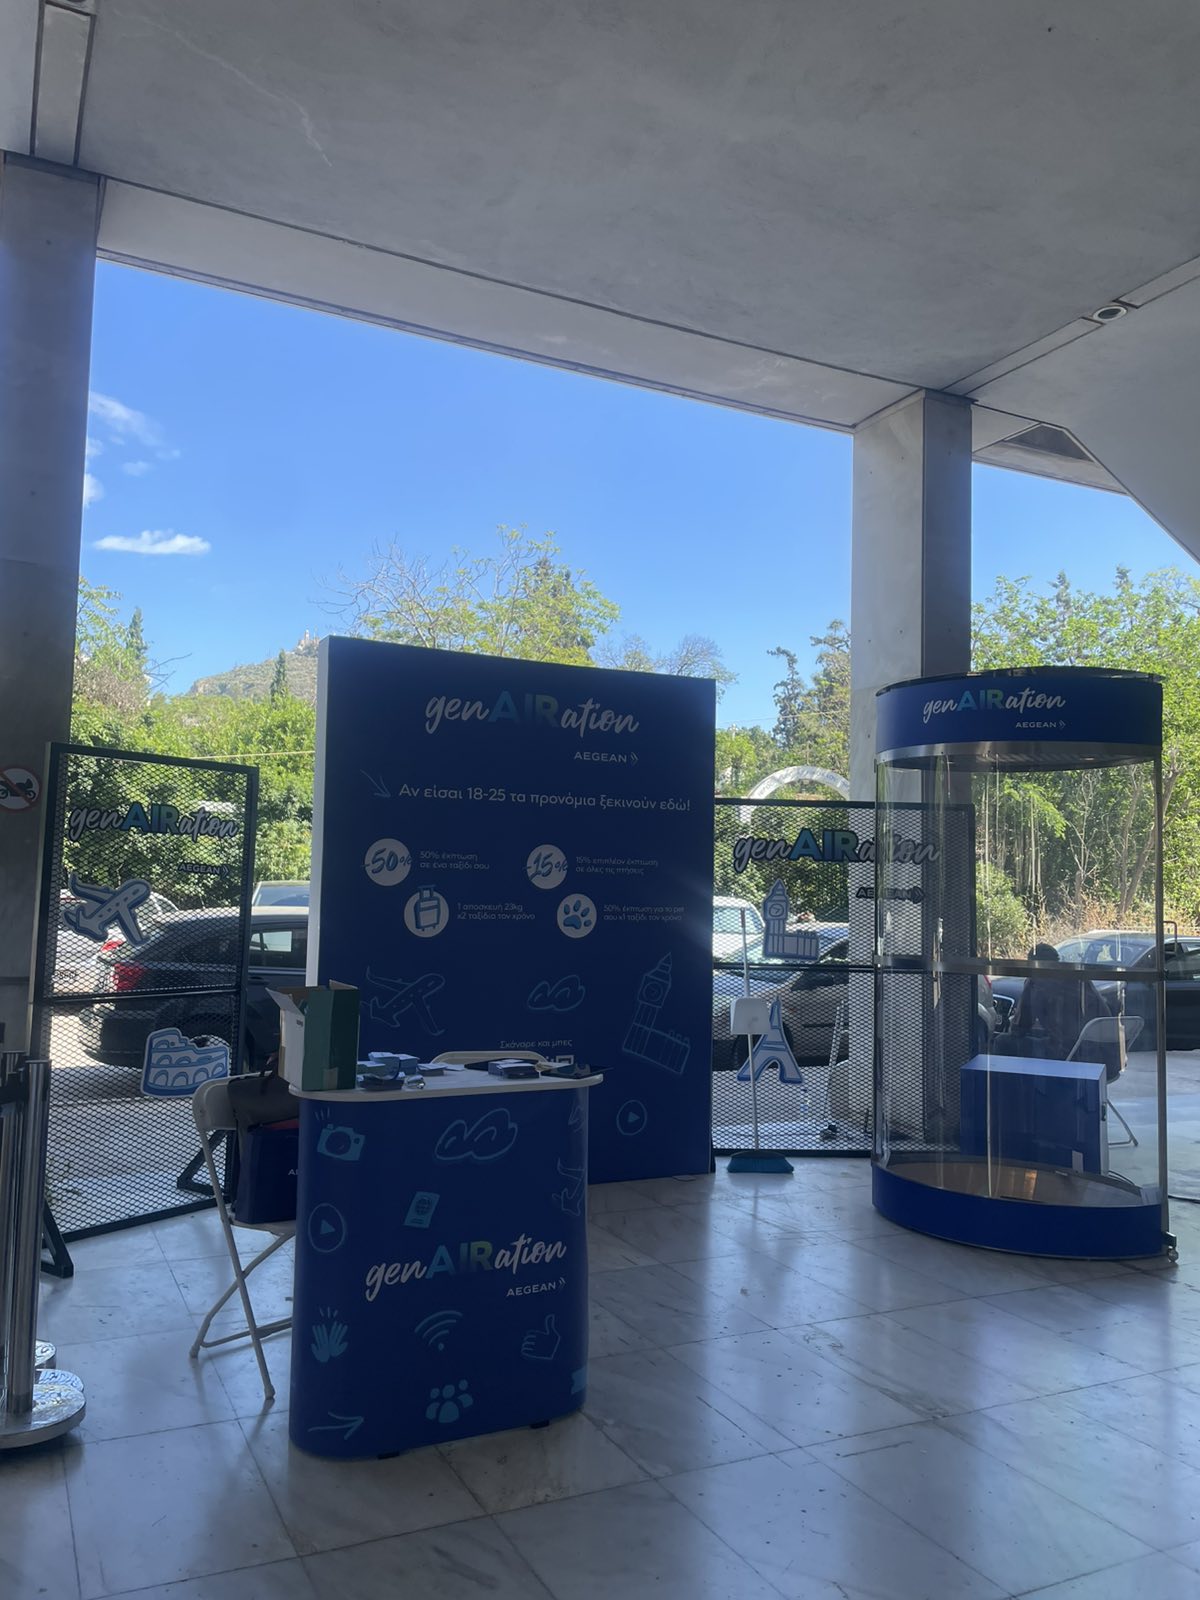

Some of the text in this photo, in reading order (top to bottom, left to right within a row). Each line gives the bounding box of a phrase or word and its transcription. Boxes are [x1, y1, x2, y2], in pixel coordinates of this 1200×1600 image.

[424, 690, 640, 738] genAIRation
[923, 687, 1066, 724] genAIRation
[1015, 721, 1057, 729] AEGEAN
[574, 751, 627, 763] AEGEAN
[399, 784, 691, 812] Αν είσαι 18-25 τα προνόμια ξεκινούν εδώ!
[68, 802, 239, 842] genAIRation
[178, 863, 220, 875] AEGEAN
[856, 886, 912, 899] AEEAN
[365, 1233, 567, 1301] genAIRation
[506, 1282, 557, 1297] AEGEAN
